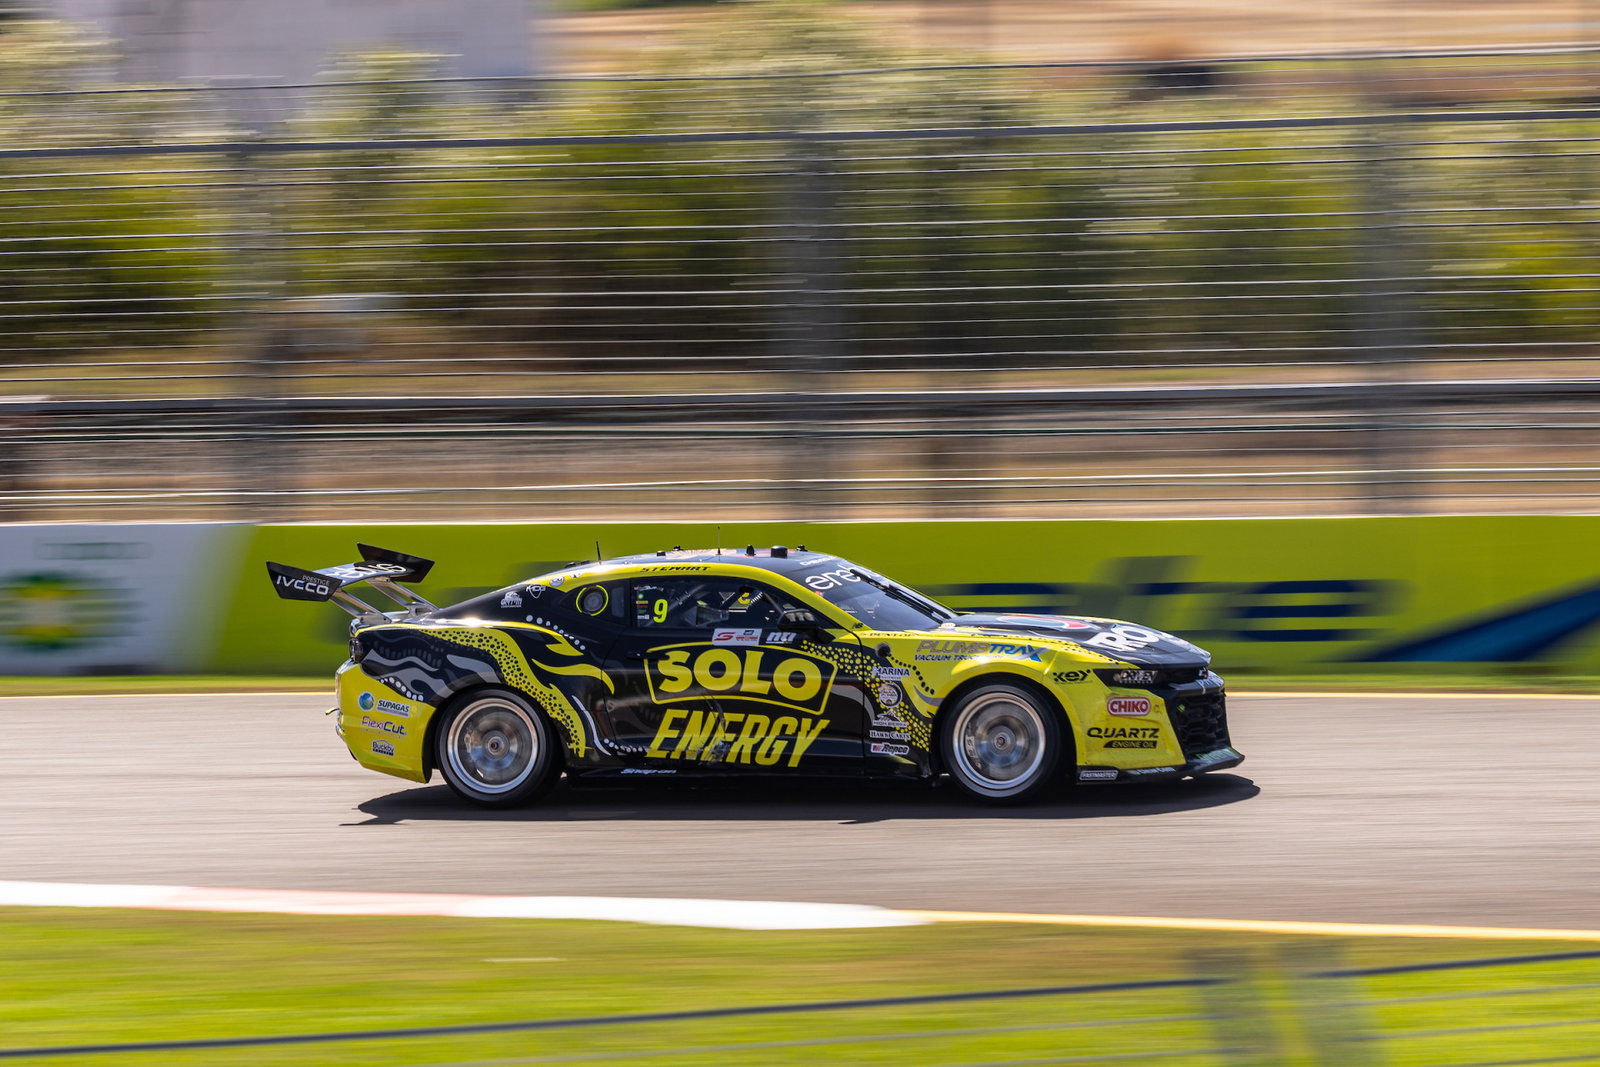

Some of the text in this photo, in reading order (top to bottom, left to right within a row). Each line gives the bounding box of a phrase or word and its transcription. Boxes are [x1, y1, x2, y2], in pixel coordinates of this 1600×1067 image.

[276, 575, 329, 596] IVECO
[302, 574, 330, 587] PRESTIGE
[653, 598, 669, 623] 9
[657, 648, 822, 701] SOLO
[377, 700, 410, 713] SUPAGAS
[1110, 700, 1148, 713] CHIKO
[645, 708, 830, 768] ENERGY
[1086, 727, 1160, 739] QUARTZ
[1112, 740, 1141, 748] ENGINE
